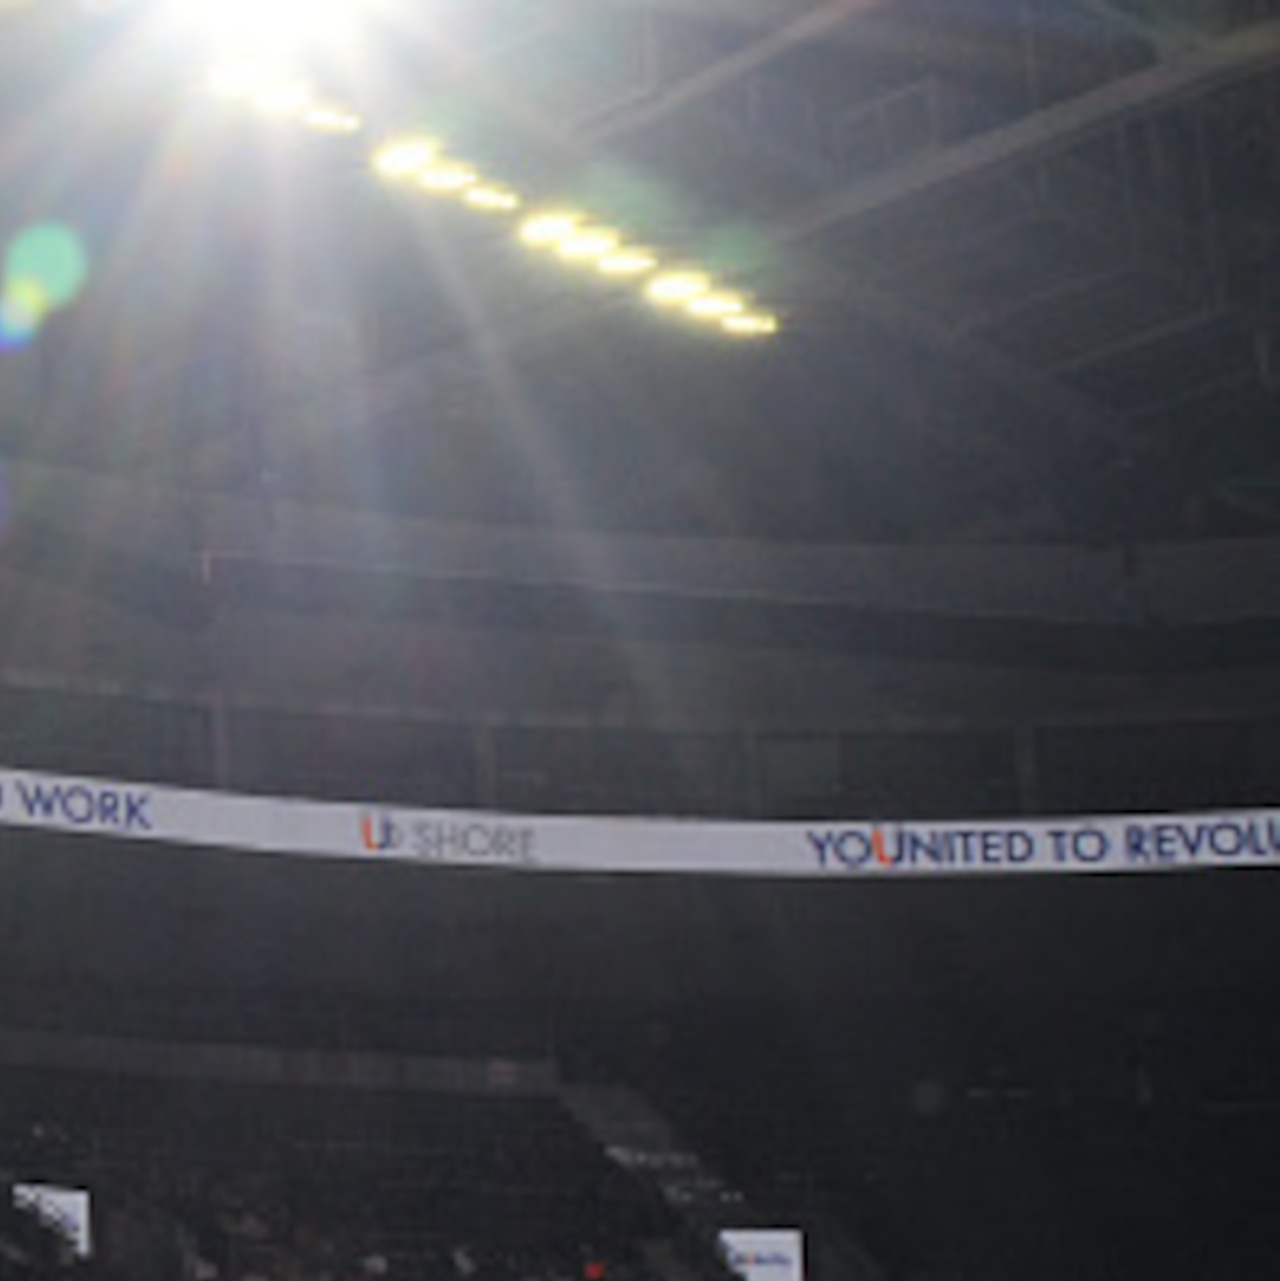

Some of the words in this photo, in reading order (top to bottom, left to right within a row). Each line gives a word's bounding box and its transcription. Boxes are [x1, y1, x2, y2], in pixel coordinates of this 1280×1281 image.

[16, 779, 152, 830] WORK
[411, 819, 537, 866] SHORE
[807, 821, 1033, 869] YOUNITED
[1046, 827, 1111, 864] TO
